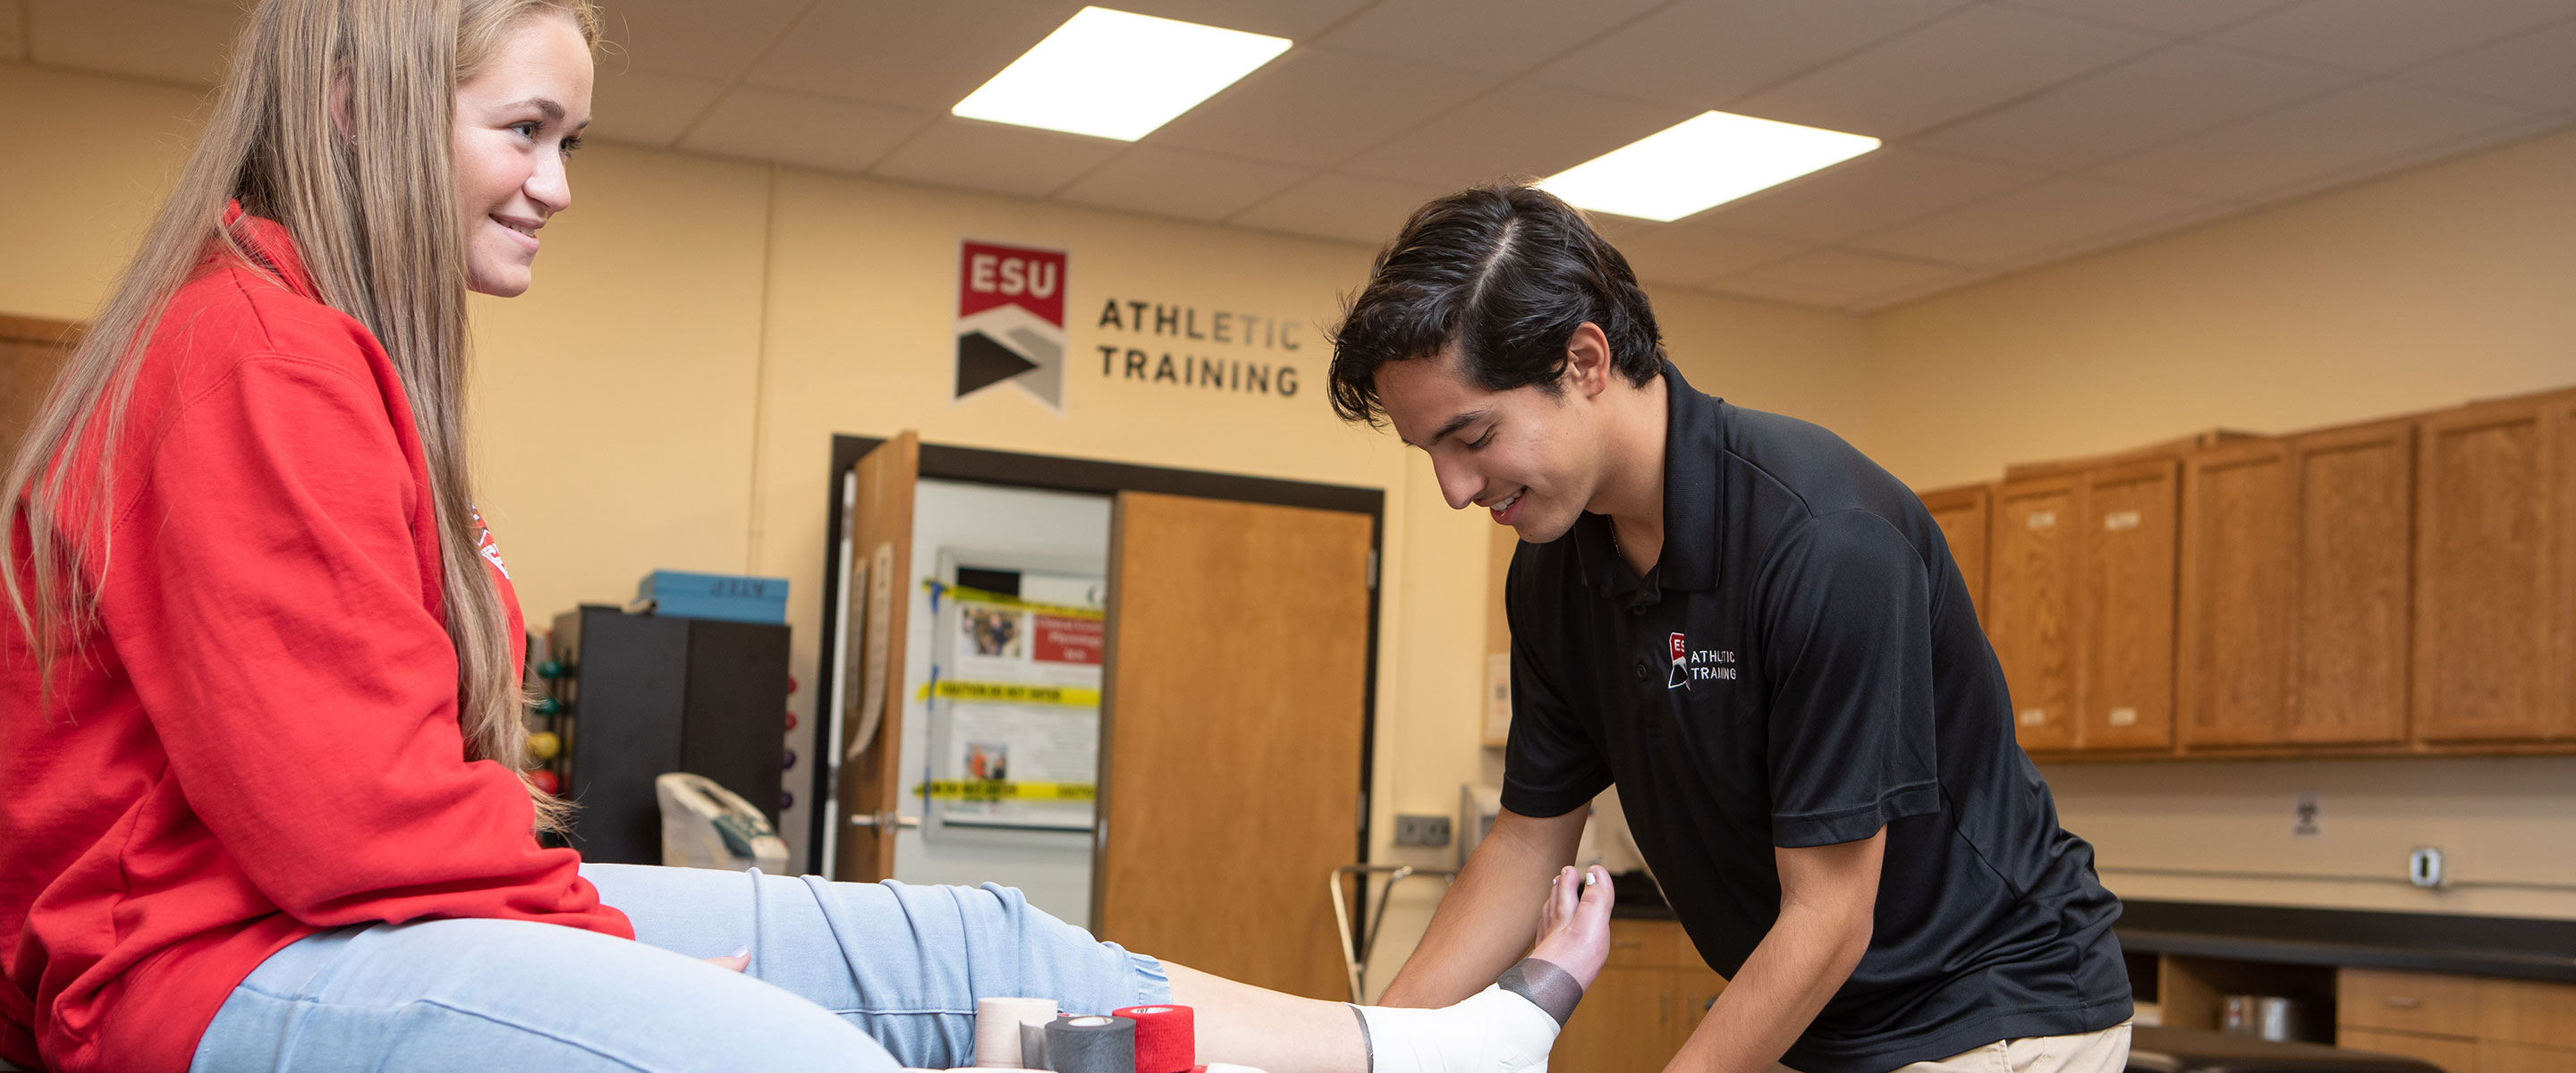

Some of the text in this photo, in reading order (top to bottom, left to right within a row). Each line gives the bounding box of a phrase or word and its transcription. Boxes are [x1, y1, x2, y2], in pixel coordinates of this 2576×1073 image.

[970, 254, 1056, 299] ESU
[1097, 298, 1301, 351] ATHLETIC
[1097, 346, 1300, 397] TRAINING
[1674, 638, 1685, 653] ES
